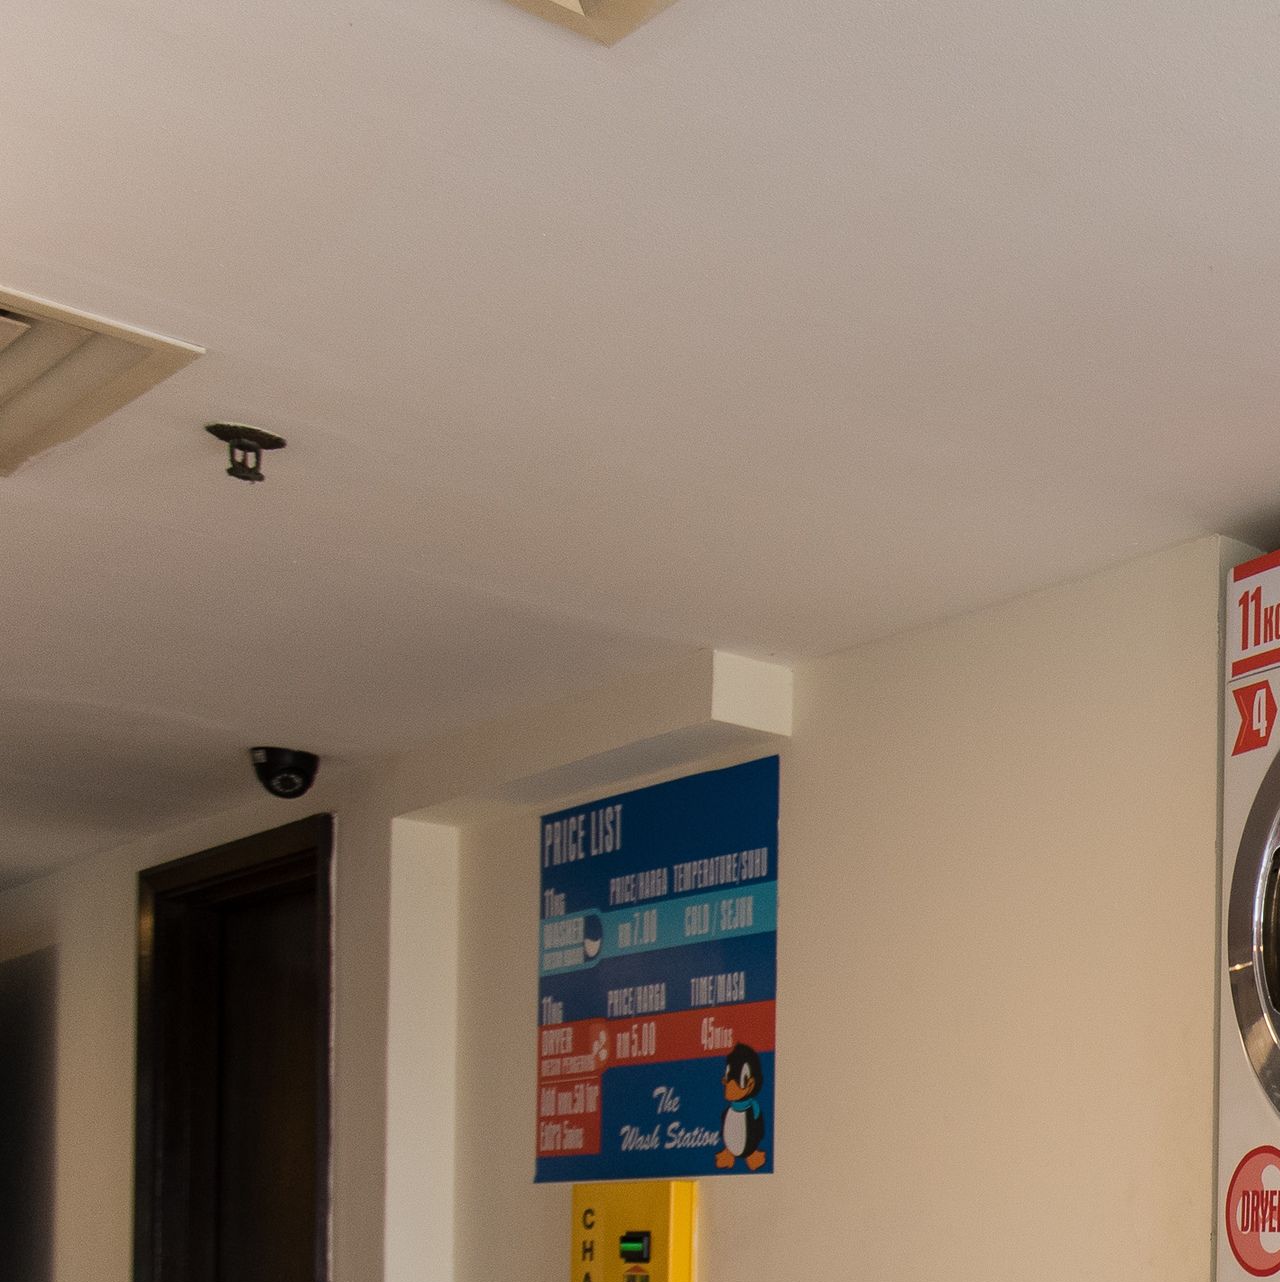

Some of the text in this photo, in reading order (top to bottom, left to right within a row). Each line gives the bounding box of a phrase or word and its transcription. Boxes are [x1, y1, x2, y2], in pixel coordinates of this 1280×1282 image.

[1252, 689, 1268, 738] 4
[544, 804, 623, 868] PRICE LIST
[690, 972, 745, 1007] TIME/MASA
[653, 1086, 681, 1114] The
[620, 1122, 720, 1150] Wash Station
